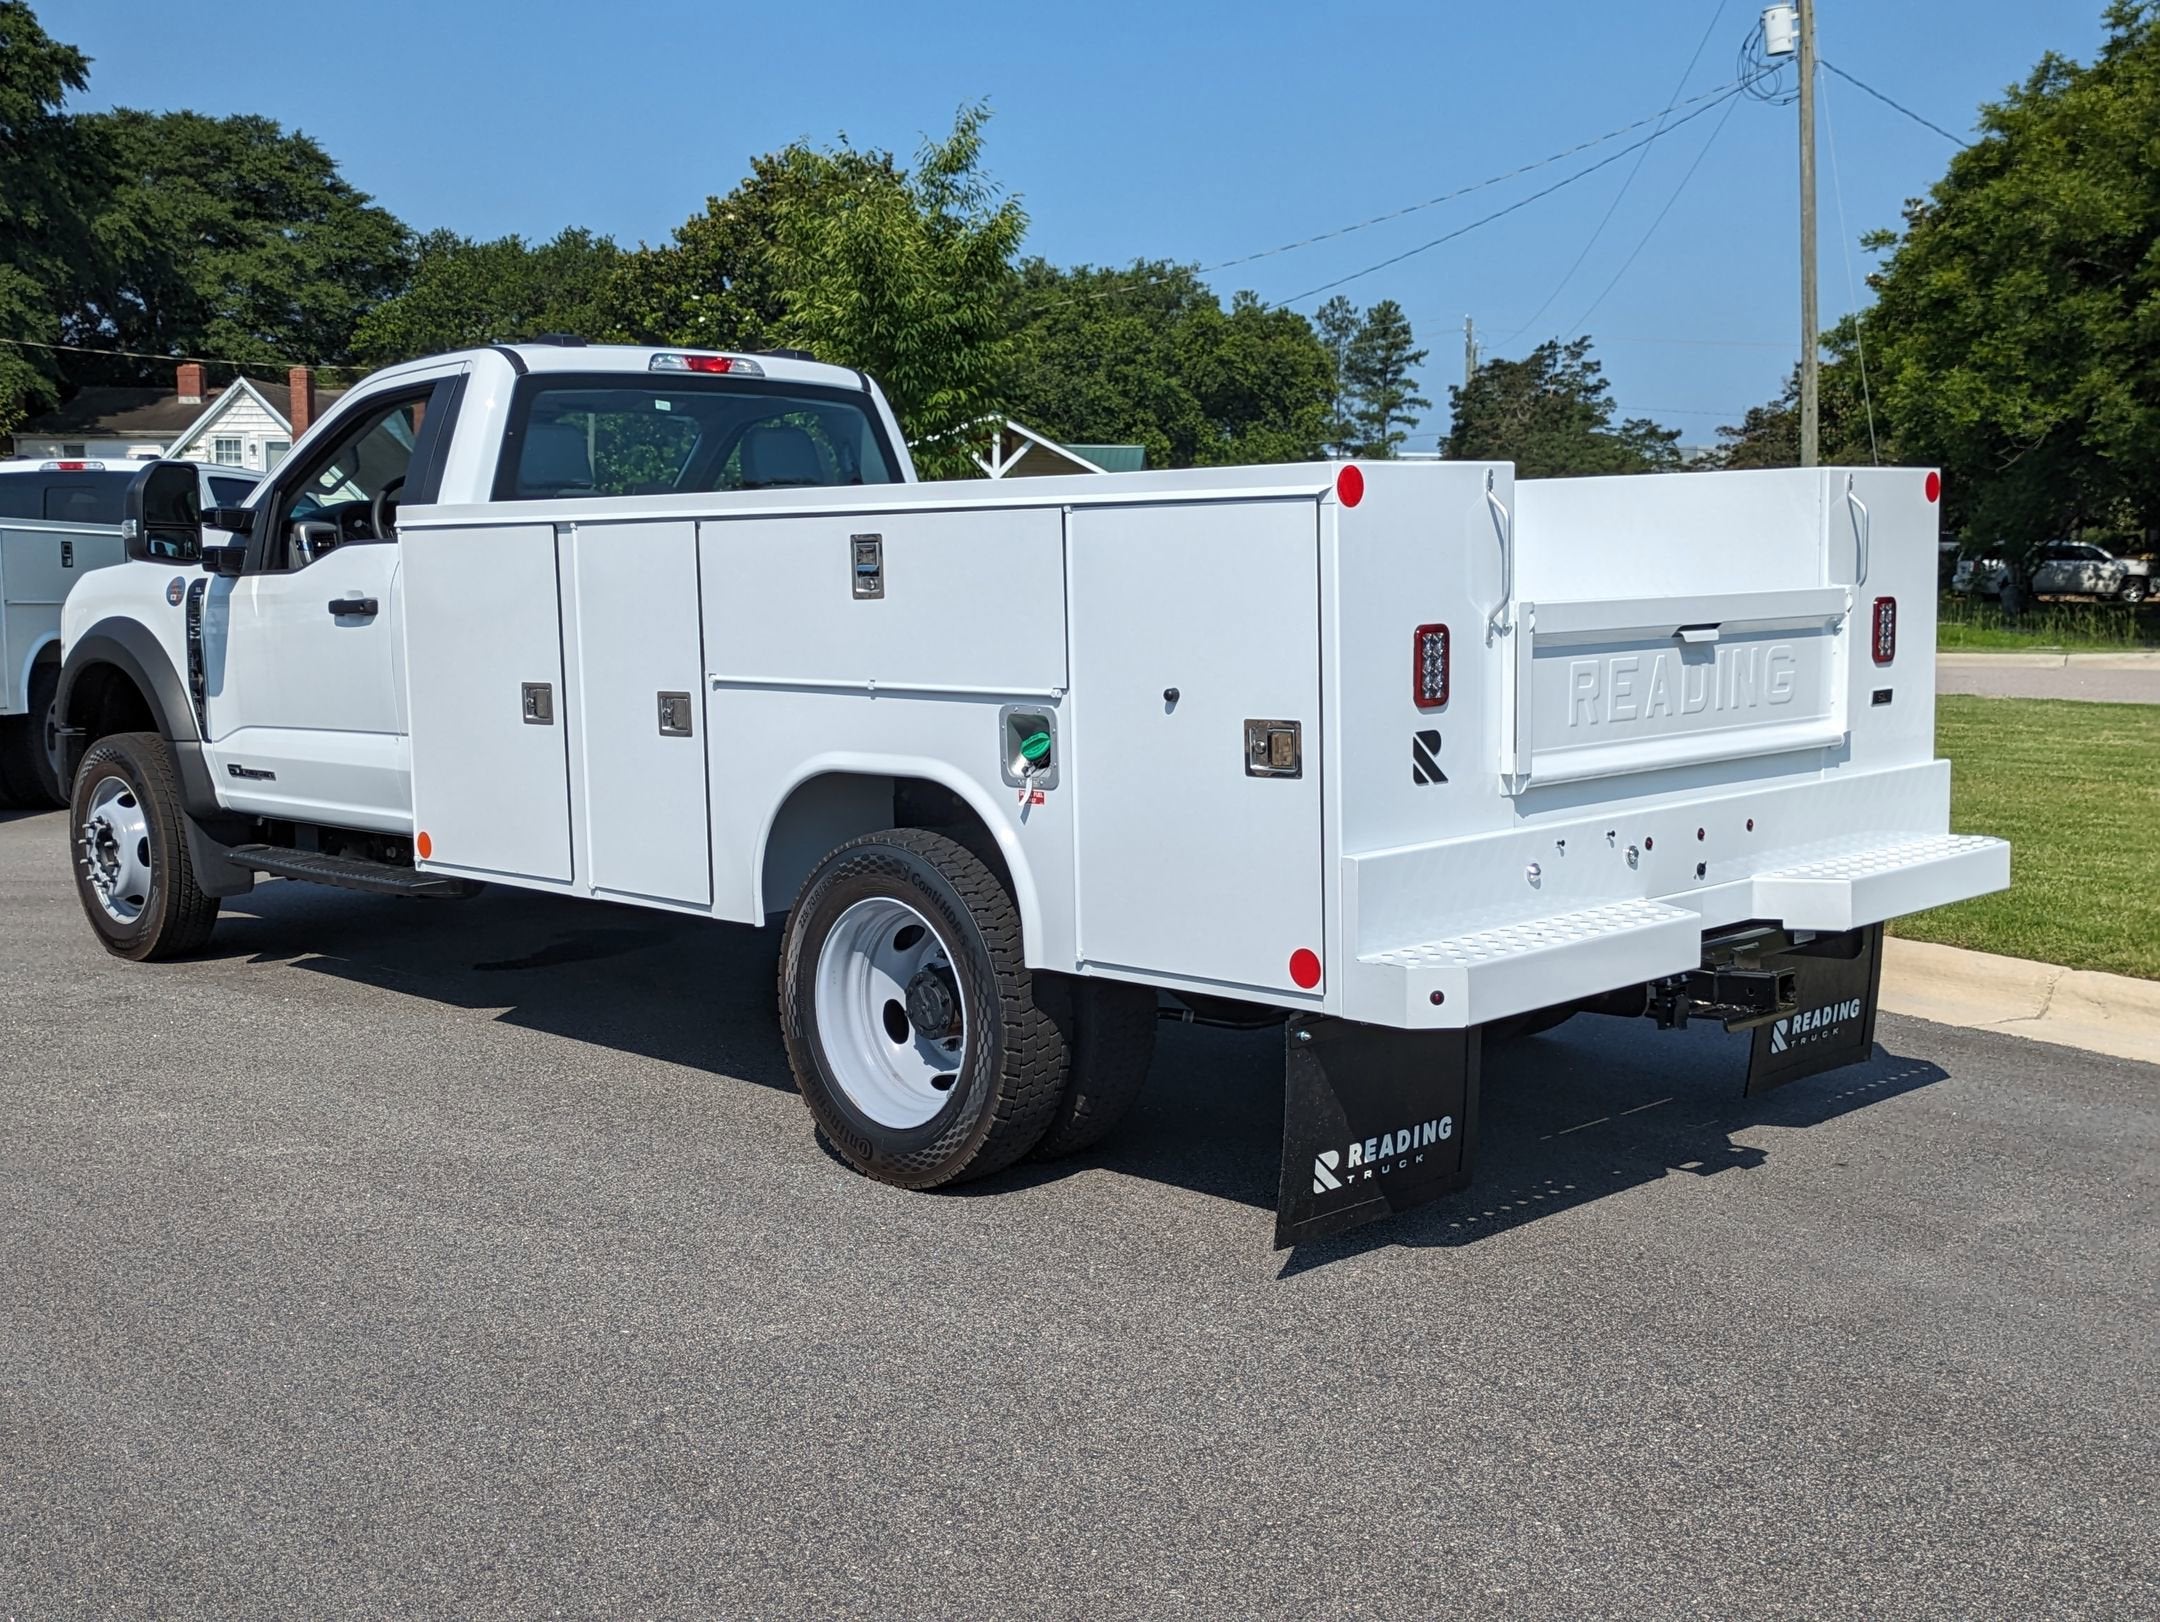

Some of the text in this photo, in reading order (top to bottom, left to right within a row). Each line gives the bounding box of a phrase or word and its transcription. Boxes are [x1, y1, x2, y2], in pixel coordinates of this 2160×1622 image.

[1568, 644, 1796, 727] READING
[1791, 998, 1861, 1035] READING
[1791, 1027, 1839, 1048] TRUCK
[1348, 1116, 1453, 1168] READING
[1347, 1154, 1424, 1184] TRUCK
